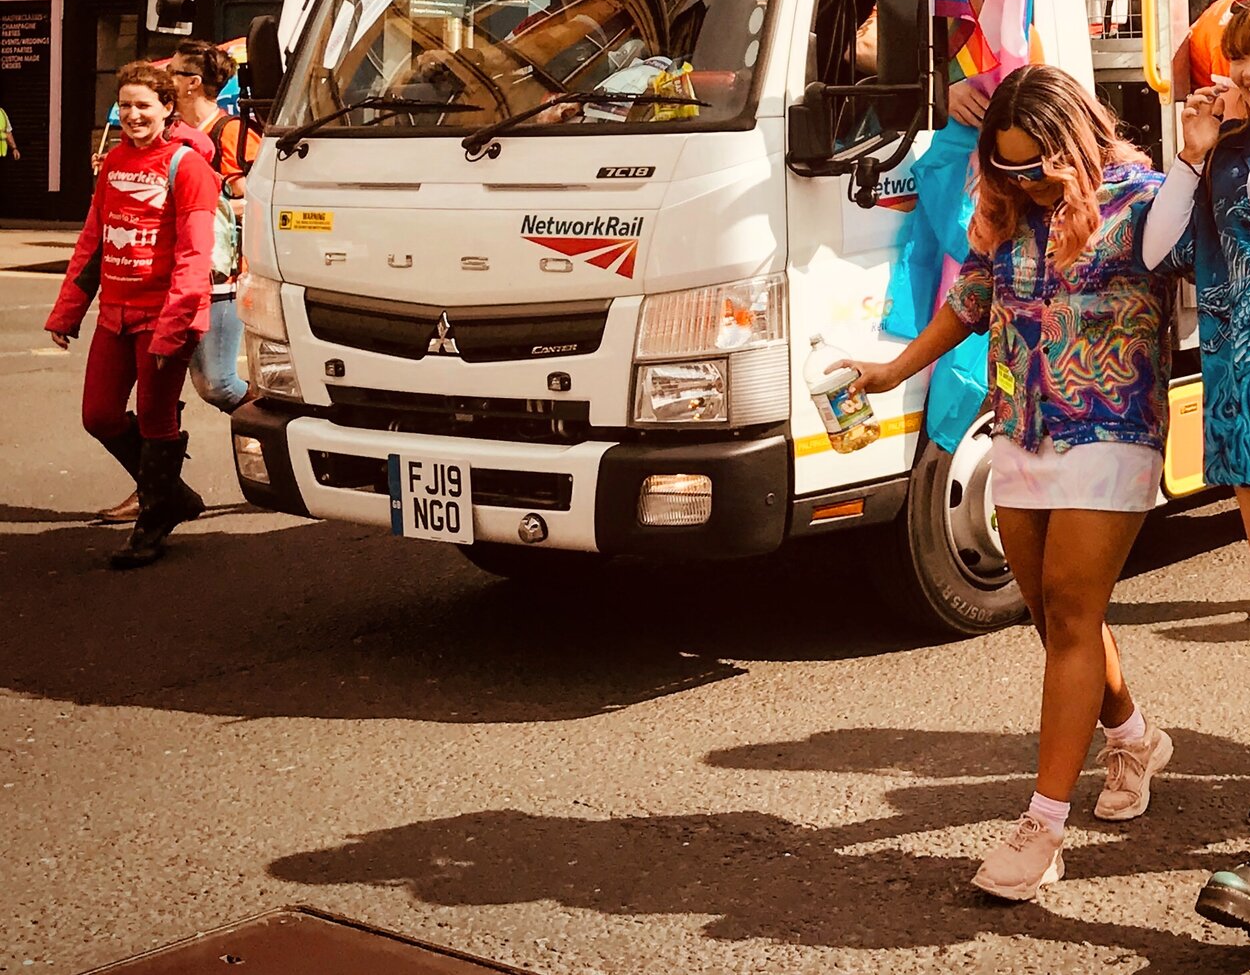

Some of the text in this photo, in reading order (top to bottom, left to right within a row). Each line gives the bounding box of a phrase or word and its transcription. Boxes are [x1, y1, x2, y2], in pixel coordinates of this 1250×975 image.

[605, 167, 650, 177] 7C18
[876, 176, 916, 196] etwo
[520, 214, 645, 237] NetworkRail
[132, 258, 153, 268] you
[324, 251, 574, 273] FUSO
[531, 343, 578, 355] CANTER
[408, 460, 463, 498] FJ19
[413, 497, 461, 534] NGO
